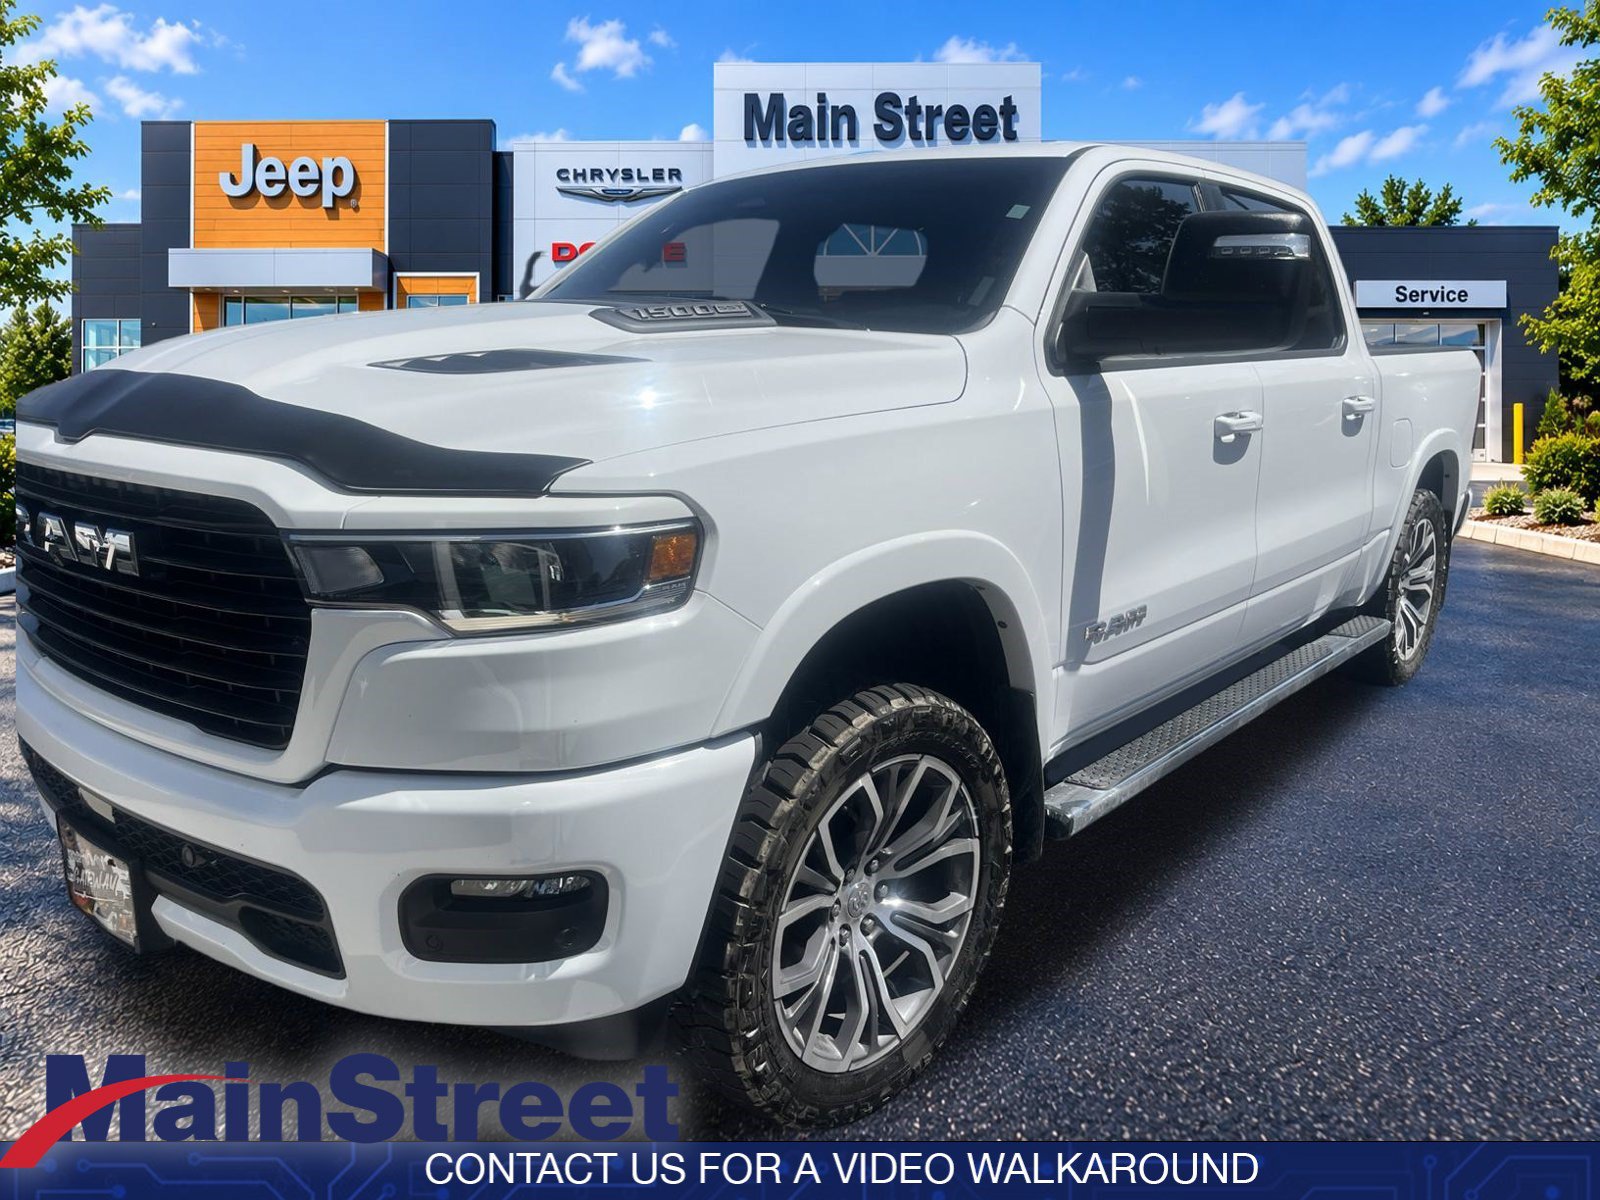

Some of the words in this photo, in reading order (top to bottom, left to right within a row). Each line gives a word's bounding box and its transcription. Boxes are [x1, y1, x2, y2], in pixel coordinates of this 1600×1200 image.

[744, 92, 858, 141] Main
[873, 91, 1018, 141] Street
[219, 143, 355, 208] Jeep
[556, 168, 682, 182] CHRYSLER
[1395, 285, 1468, 303] Service
[635, 304, 714, 319] 1500
